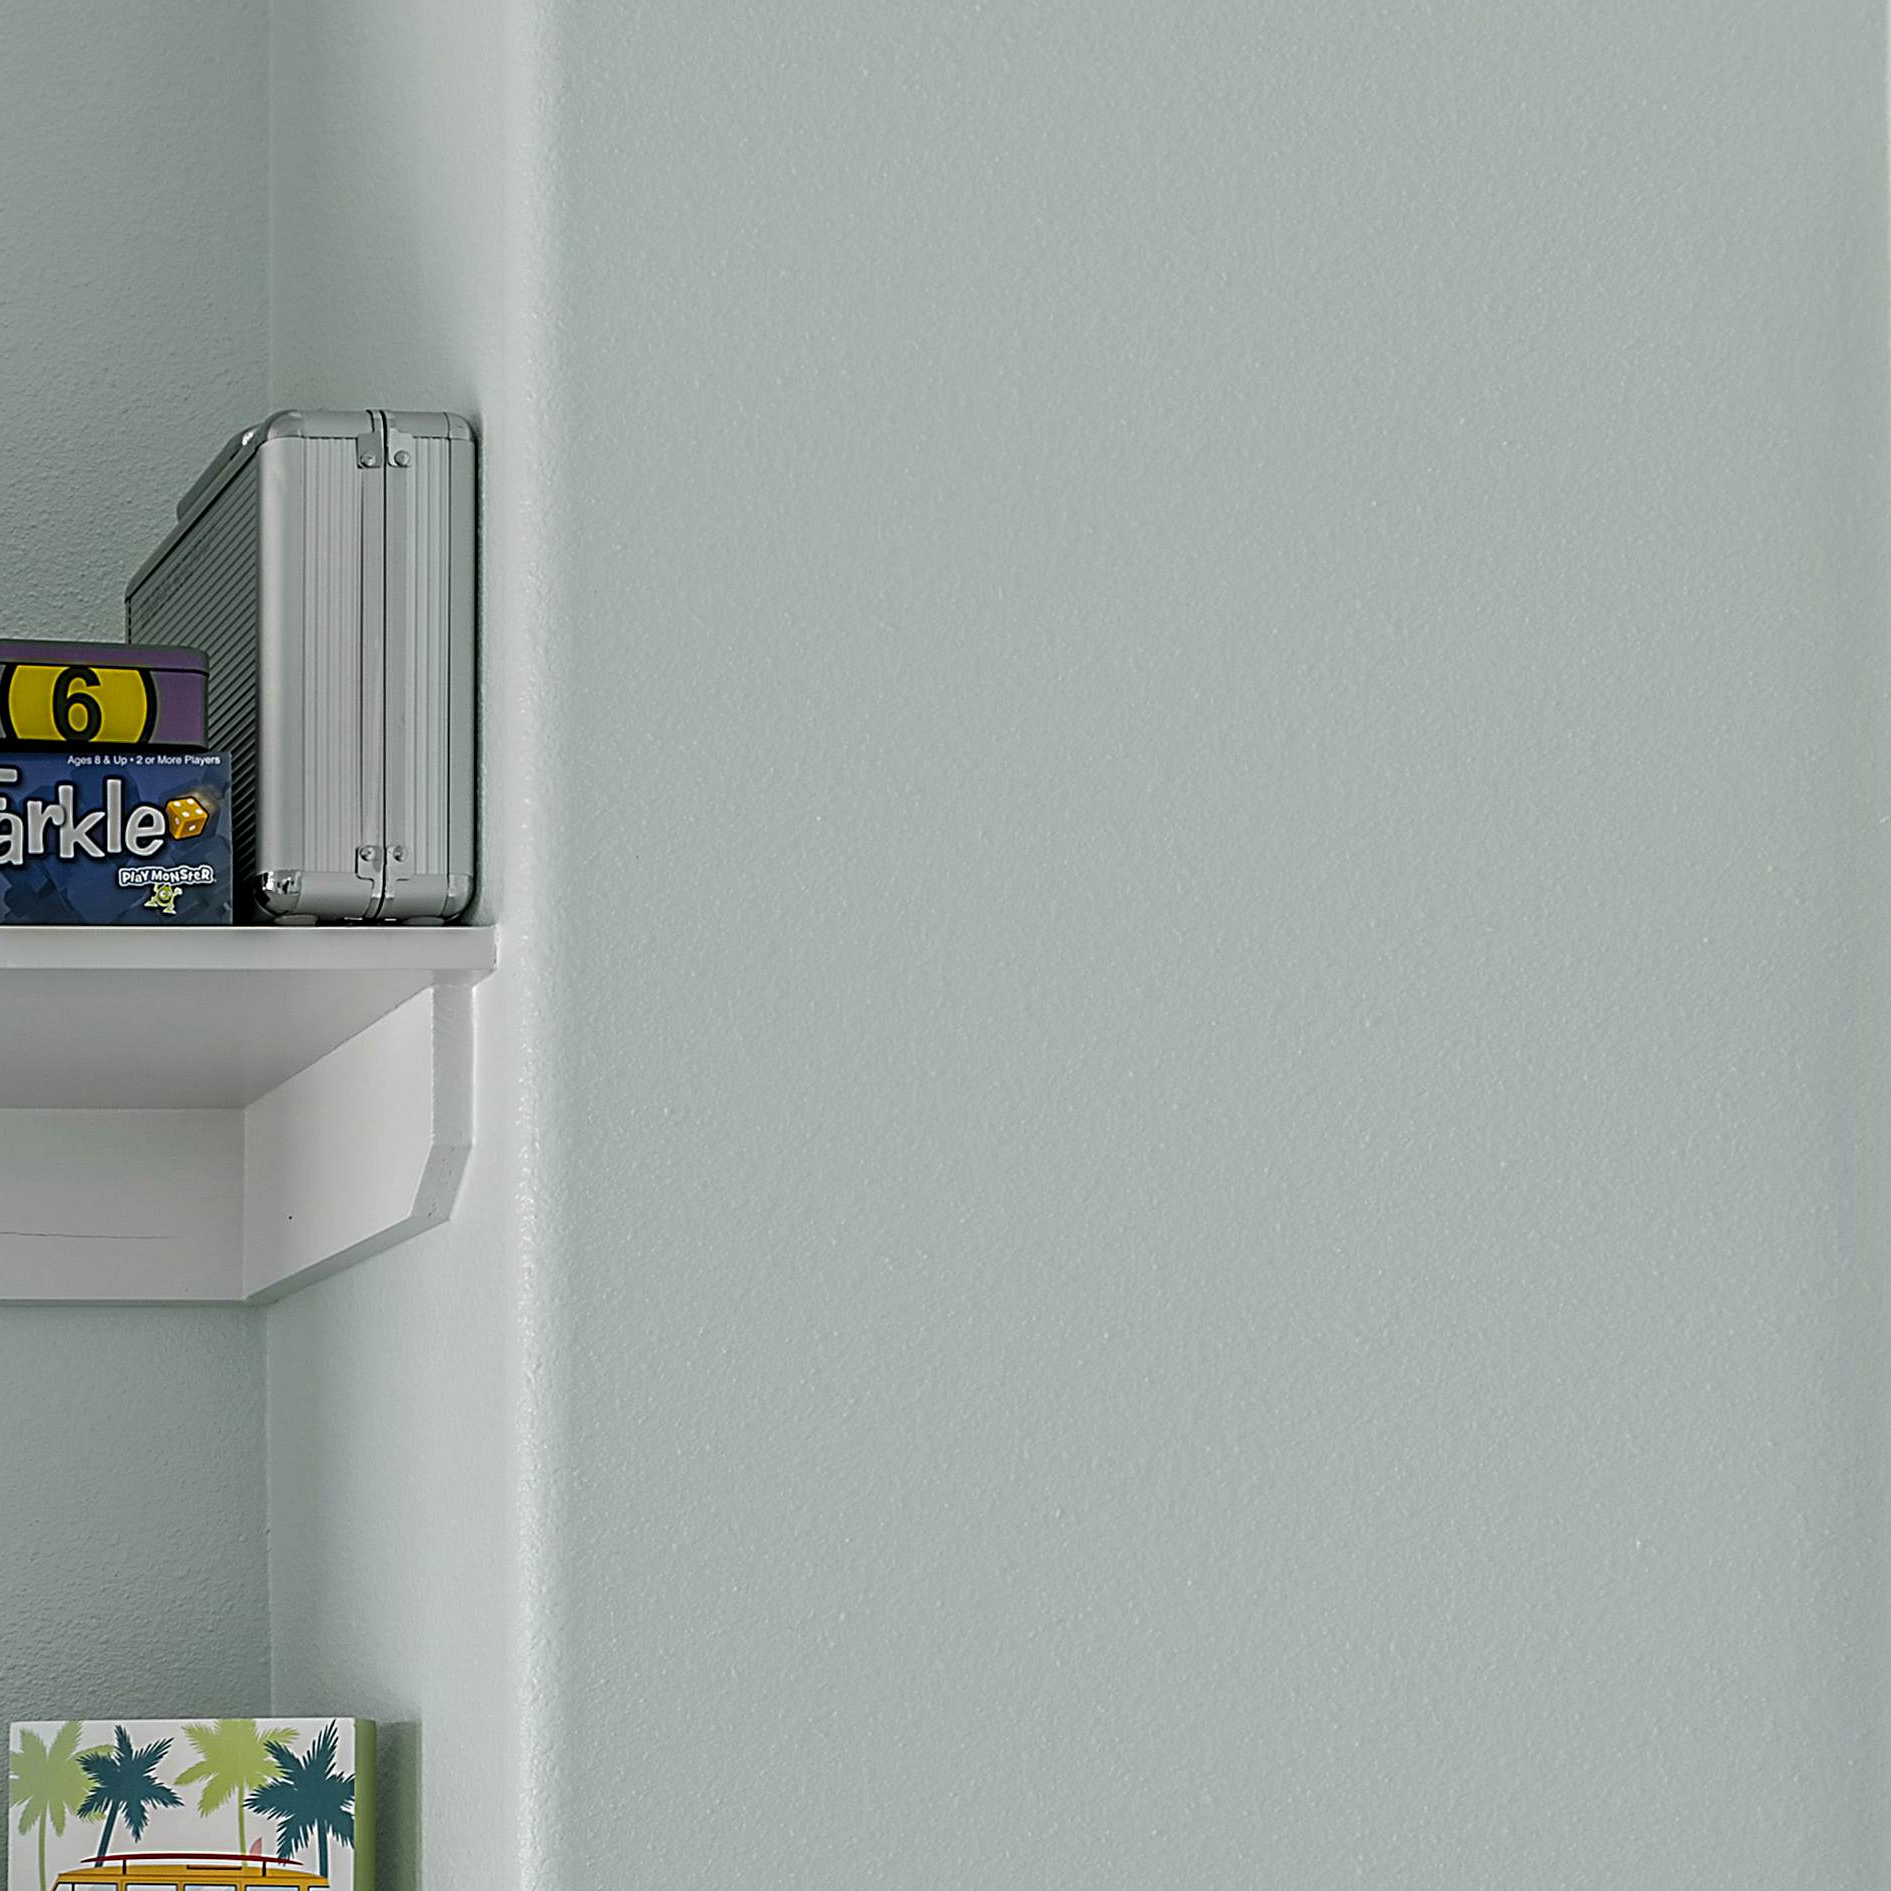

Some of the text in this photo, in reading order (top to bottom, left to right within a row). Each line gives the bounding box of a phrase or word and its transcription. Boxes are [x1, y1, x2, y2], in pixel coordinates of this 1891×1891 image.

[52, 665, 103, 743] 6
[67, 755, 221, 767] Ages 8 & Up 2 or More Players
